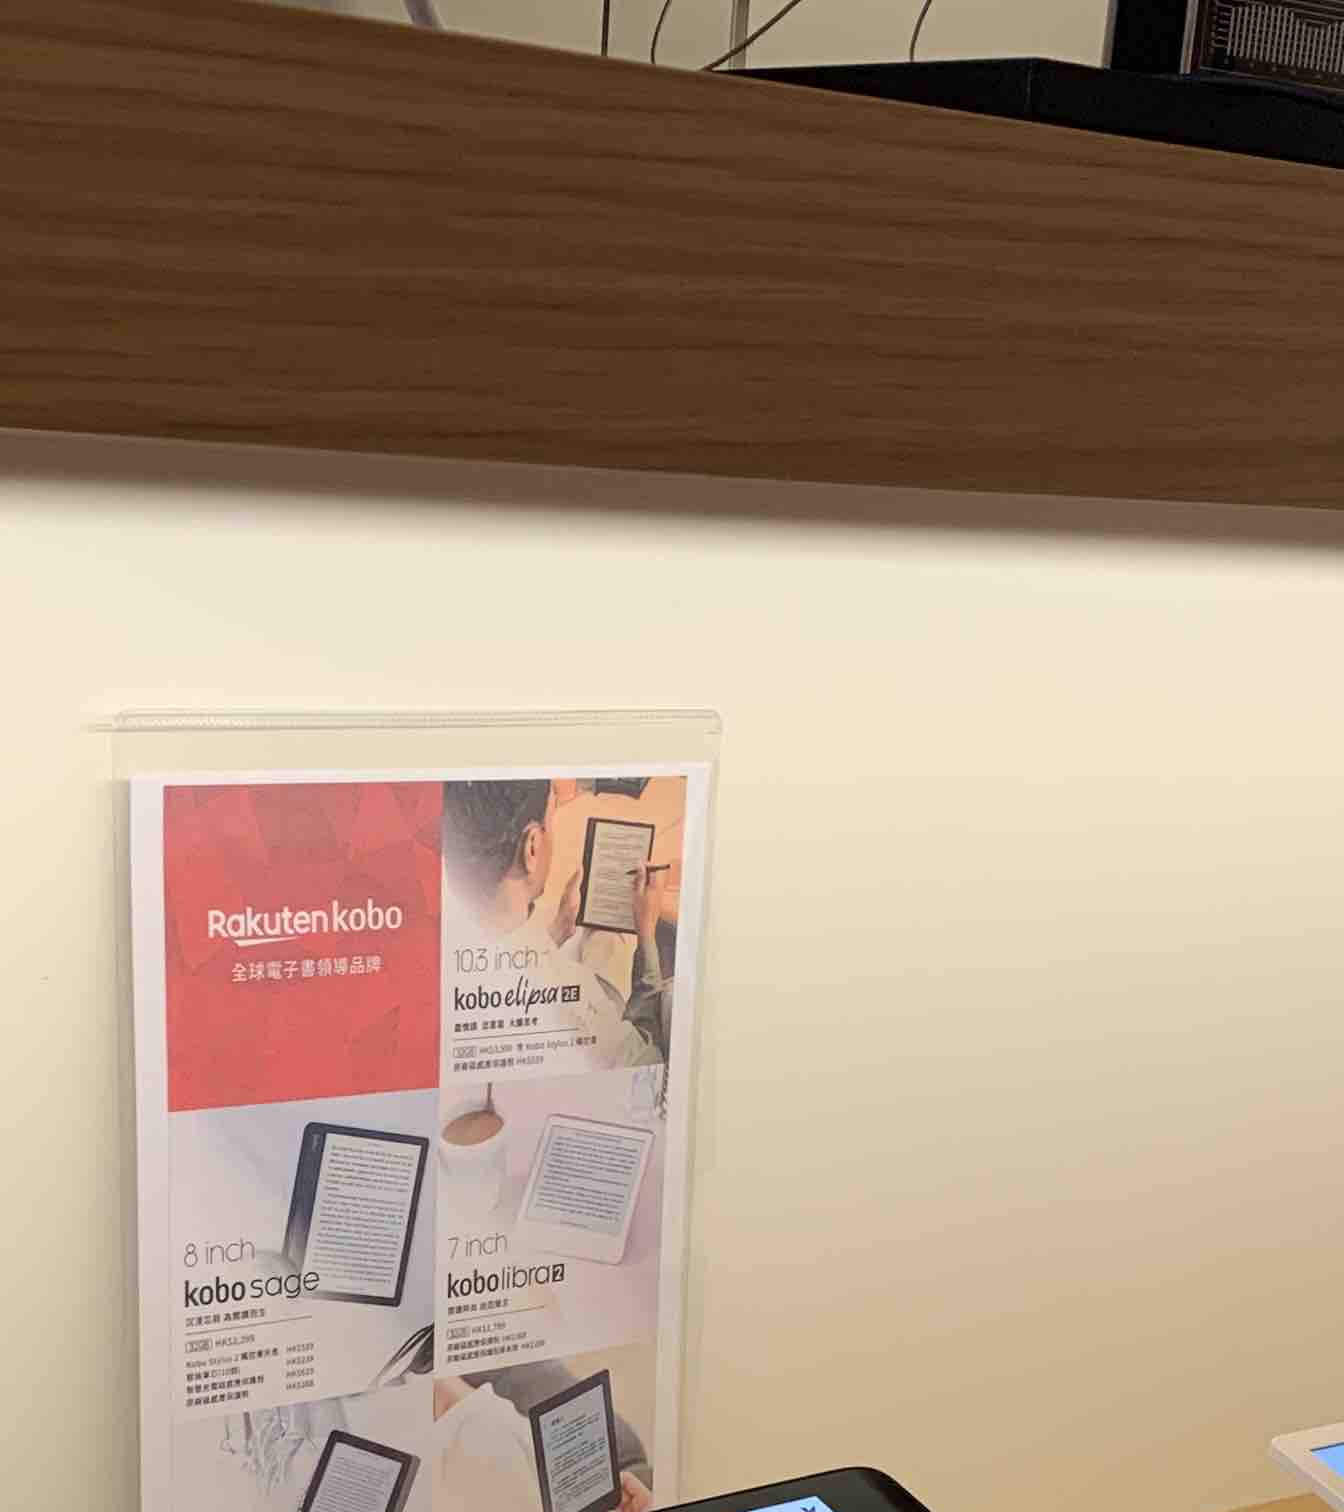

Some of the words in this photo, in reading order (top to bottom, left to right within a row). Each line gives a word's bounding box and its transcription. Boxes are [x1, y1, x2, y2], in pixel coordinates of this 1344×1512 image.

[208, 904, 328, 944] Rakuten
[331, 898, 404, 932] kobo
[494, 945, 539, 972] inch
[454, 985, 503, 1012] kobo
[504, 975, 560, 1015] elipsa
[184, 1243, 199, 1268] 8
[206, 1238, 256, 1265] inch
[448, 1236, 459, 1260] 7
[465, 1232, 508, 1258] inch
[184, 1275, 246, 1309] kobo
[250, 1271, 320, 1299] sage
[448, 1268, 499, 1299] kobo
[501, 1264, 550, 1291] libra
[552, 1263, 565, 1283] 2
